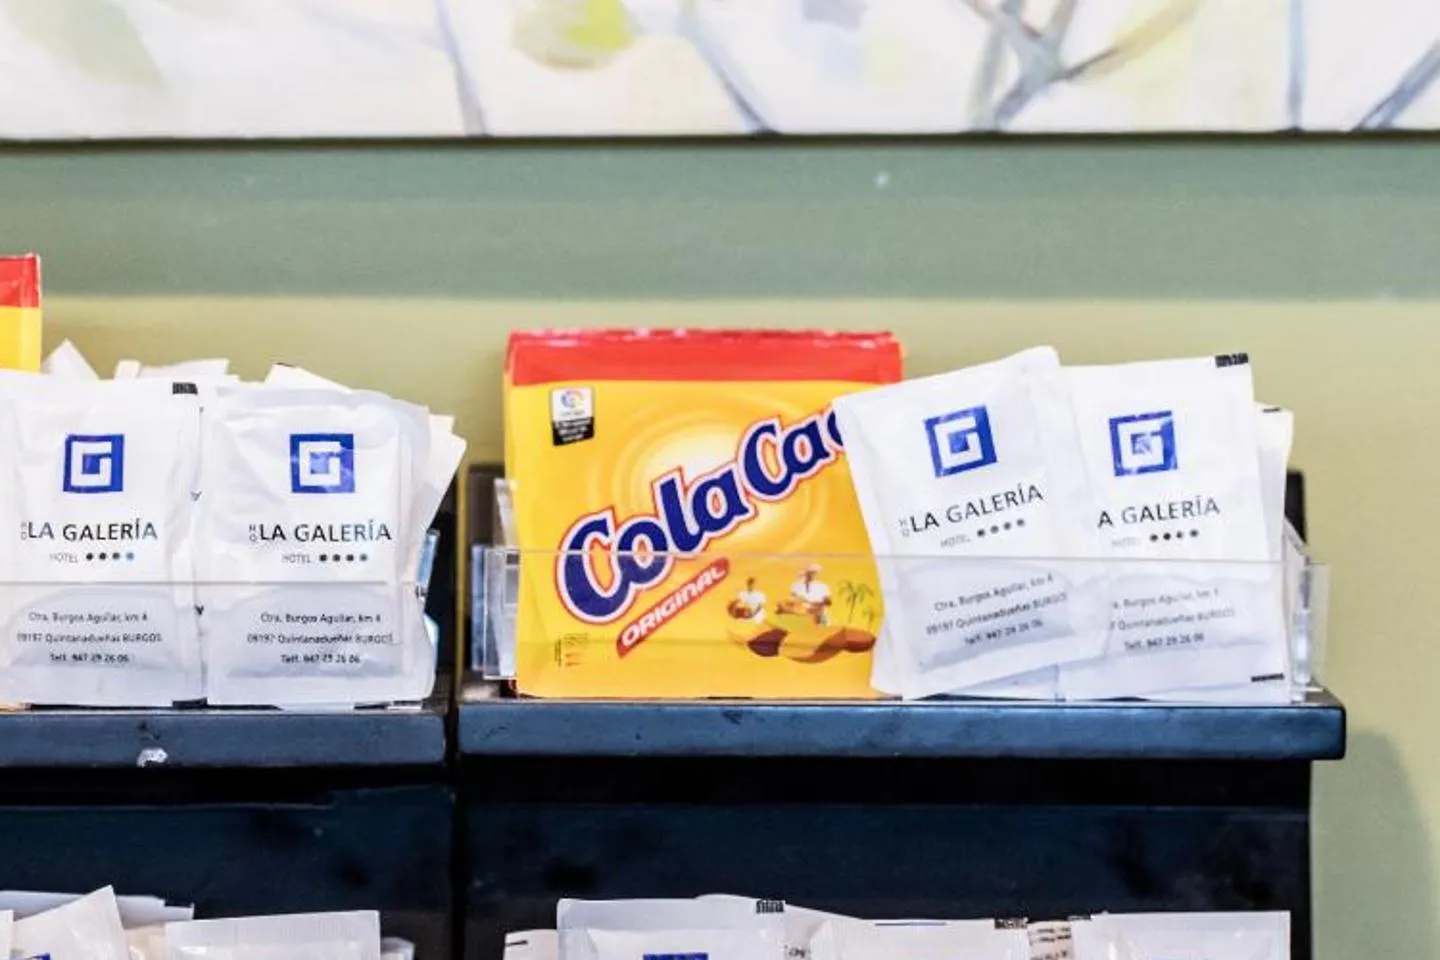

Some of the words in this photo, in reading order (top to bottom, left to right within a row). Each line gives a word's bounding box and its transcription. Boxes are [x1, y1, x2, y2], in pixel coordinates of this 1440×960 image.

[910, 512, 939, 532] LA
[946, 483, 1043, 523] GALERÍA
[1097, 510, 1113, 528] A
[28, 522, 54, 539] LA
[63, 518, 158, 541] GALERÍA
[260, 524, 286, 541] LA
[294, 519, 391, 542] GALERÍA
[621, 563, 727, 649] ORIGINAL
